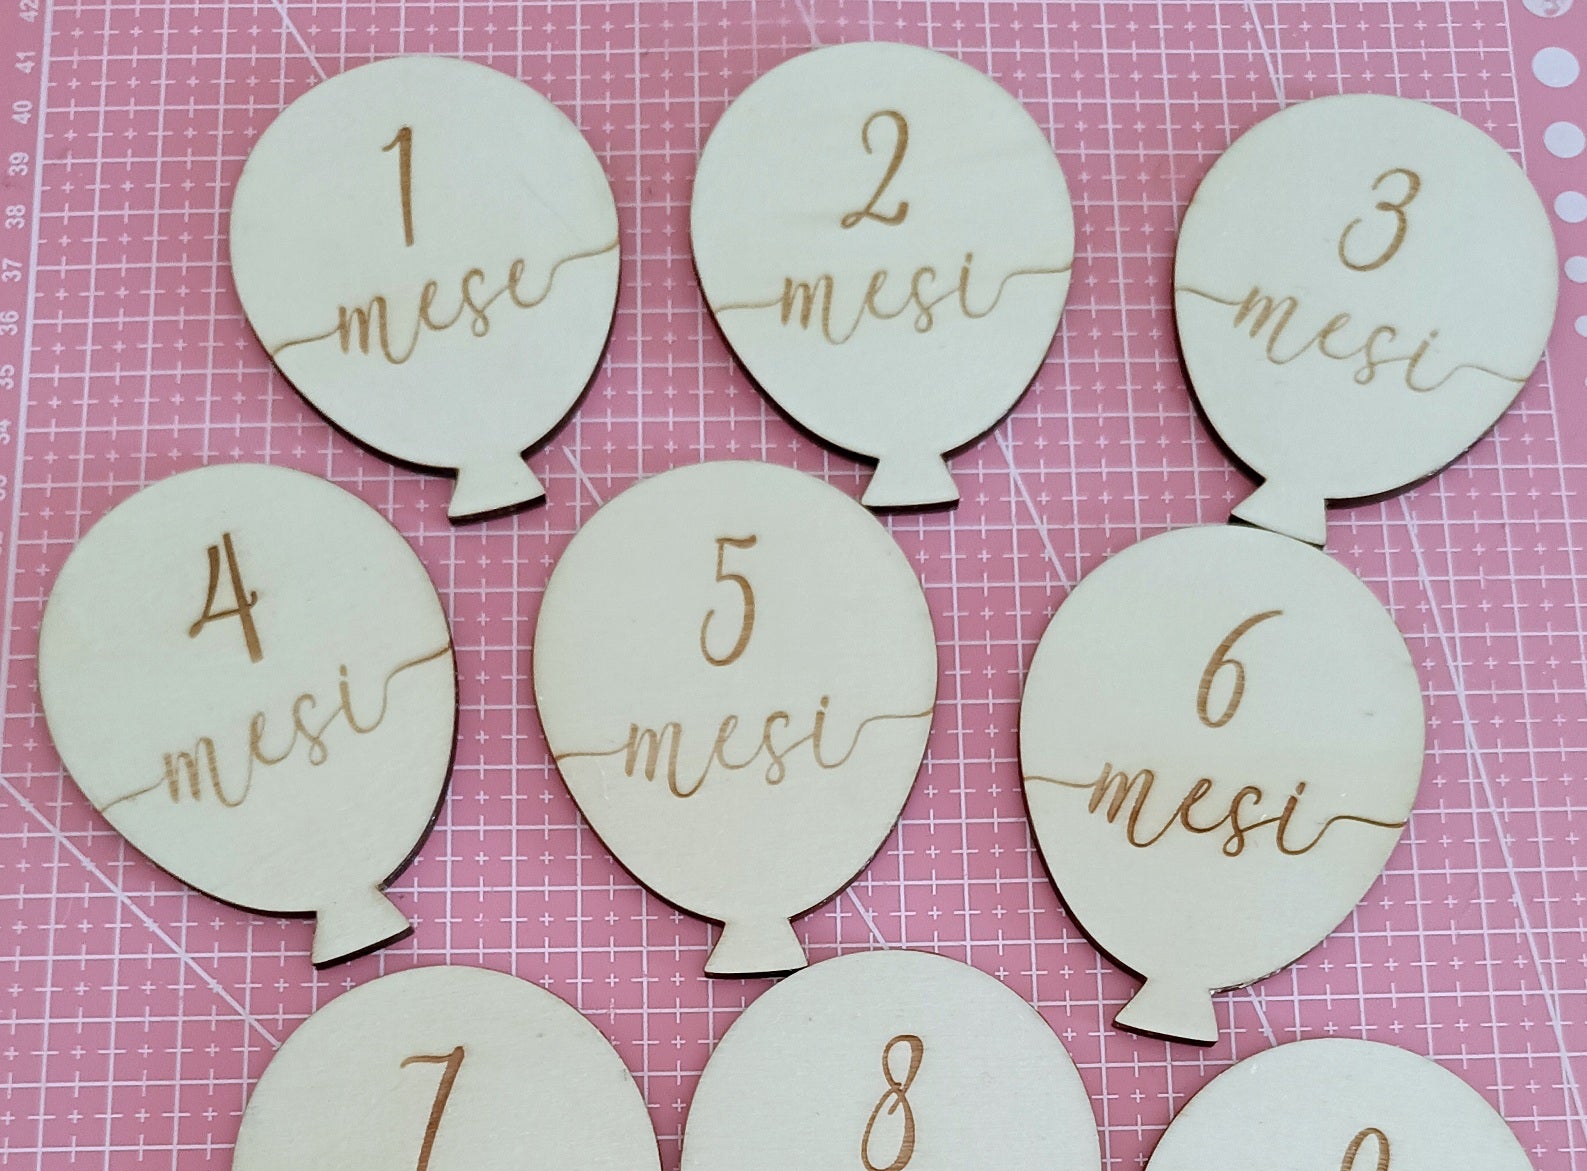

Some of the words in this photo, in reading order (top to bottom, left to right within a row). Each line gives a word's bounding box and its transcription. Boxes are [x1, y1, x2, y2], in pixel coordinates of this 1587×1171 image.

[11, 100, 33, 124] 40
[15, 51, 36, 74] 41
[8, 152, 29, 176] 39
[381, 126, 416, 247] 1
[840, 110, 909, 228] 2
[4, 204, 26, 229] 38
[1338, 168, 1421, 272] 3
[2, 257, 22, 282] 37
[337, 256, 550, 364] mese
[782, 251, 1003, 345] mesi
[0, 310, 19, 336] 36
[1234, 286, 1459, 392] mesi
[187, 531, 262, 663] 4
[700, 535, 757, 666] 5
[1196, 610, 1283, 728] 6
[161, 665, 391, 807] mesi
[625, 694, 859, 798] mesi
[1089, 762, 1331, 857] mesi
